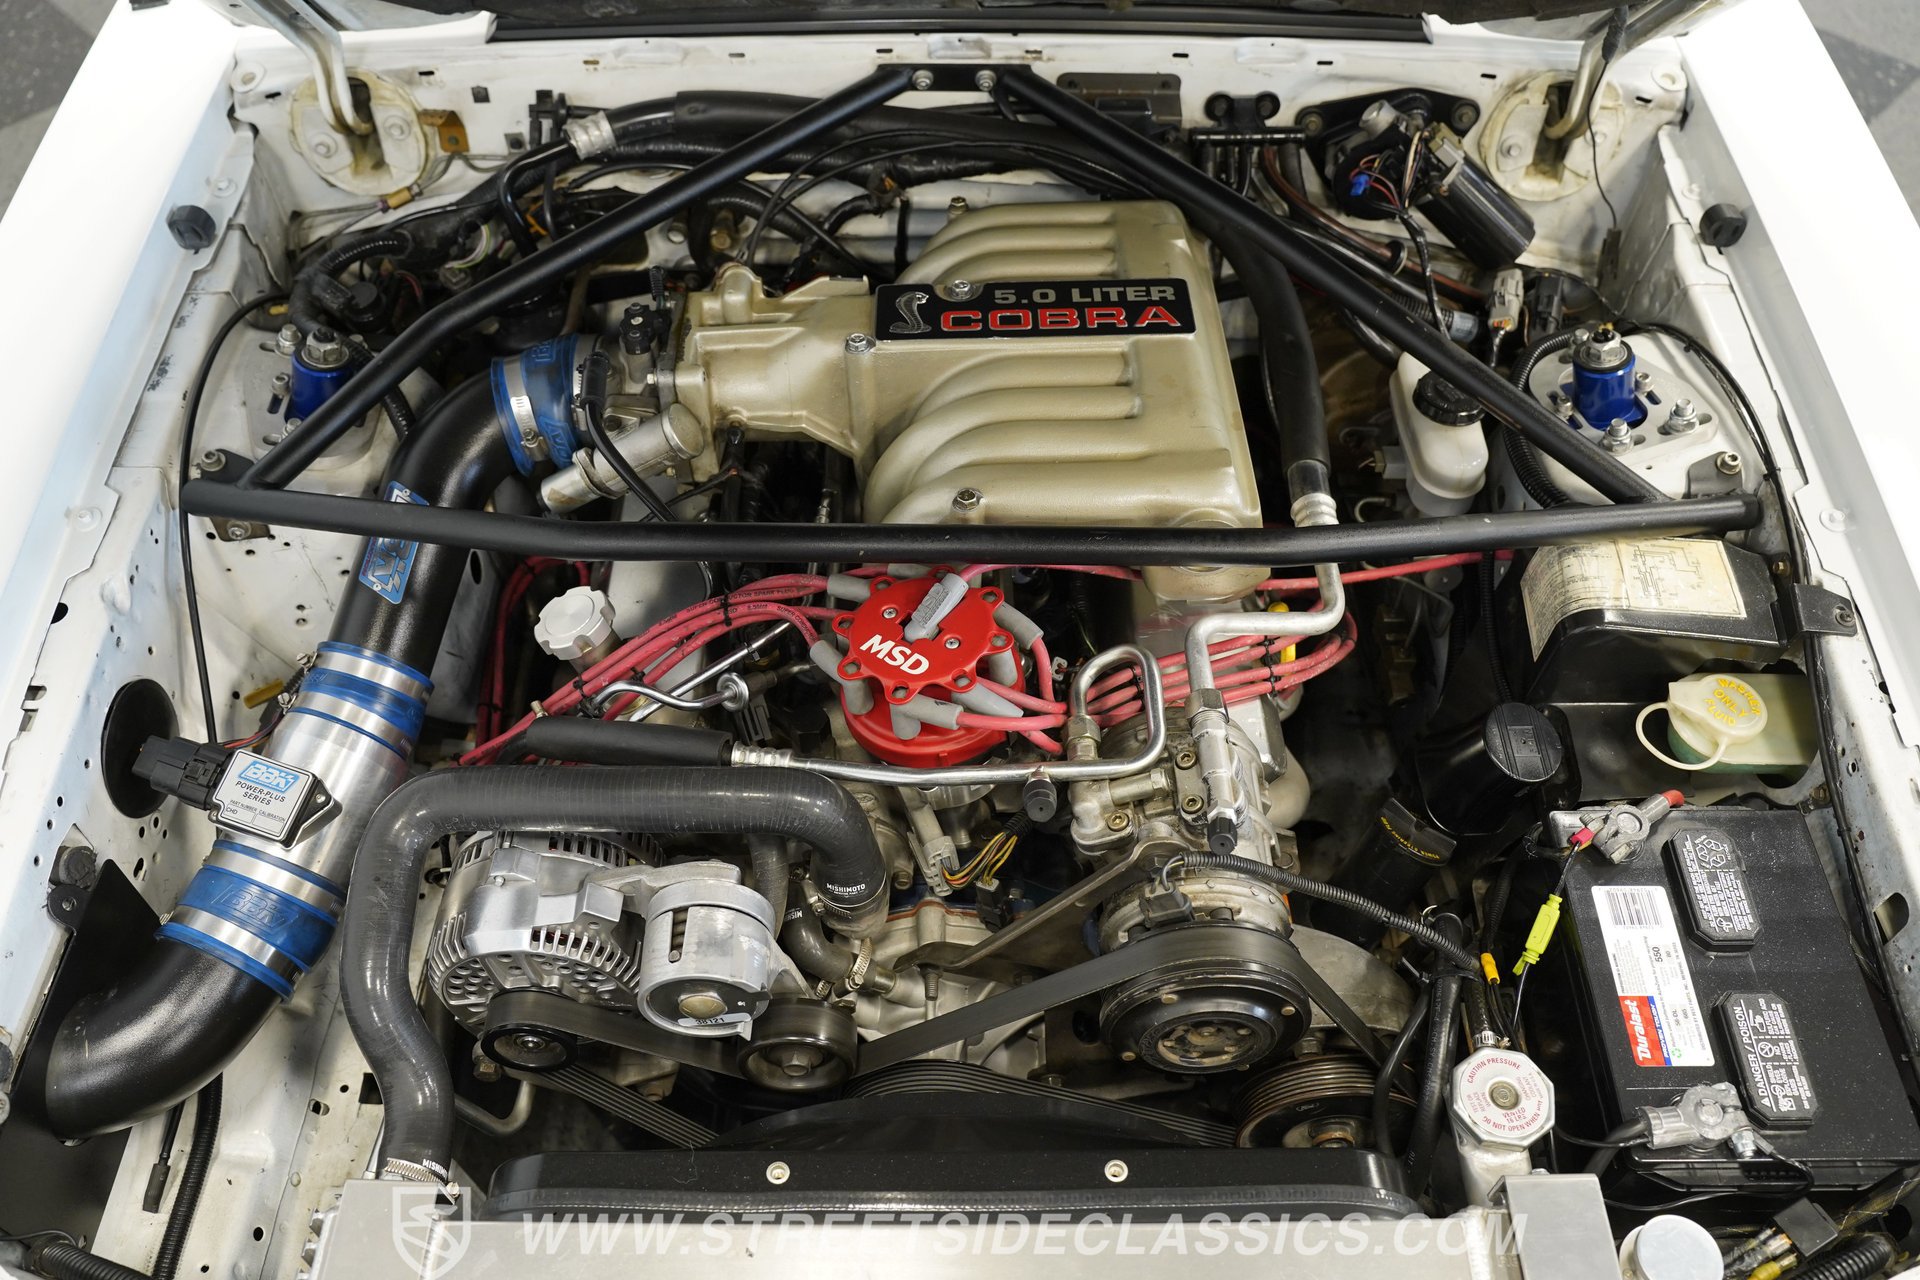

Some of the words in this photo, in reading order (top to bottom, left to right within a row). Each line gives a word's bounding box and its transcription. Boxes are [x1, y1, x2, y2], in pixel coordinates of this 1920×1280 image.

[994, 288, 1057, 304] 5.0
[1072, 286, 1176, 302] LITER
[940, 306, 1181, 332] COBRA
[860, 634, 930, 675] MSD
[1713, 689, 1749, 718] ONLY
[1717, 677, 1761, 715] WASHER
[1705, 698, 1737, 727] FLUID
[245, 763, 294, 789] BBK
[235, 780, 286, 803] POWER-PLUS
[242, 791, 272, 806] SERIES
[240, 803, 258, 812] NUMBER
[259, 810, 286, 822] CALIBRATION
[826, 883, 866, 893] MISHIMOTO
[1652, 946, 1663, 962] 550
[1759, 999, 1767, 1010] ACID
[1623, 999, 1653, 1061] Duralast
[1733, 1007, 1752, 1043] POISON
[1762, 1011, 1774, 1034] SULFURIC
[1657, 1030, 1669, 1057] PROVEN
[1774, 1046, 1782, 1055] NO
[1467, 1062, 1487, 1083] CAUTION
[1487, 1058, 1521, 1070] PRESSURE
[1747, 1055, 1768, 1095] DANGER
[1766, 1065, 1777, 1083] SHIELD
[1774, 1070, 1783, 1083] EYES
[1780, 1068, 1792, 1096] EXPLOSIVE
[1492, 1122, 1505, 1131] NOT
[1508, 1123, 1524, 1131] OPEN
[1524, 1112, 1540, 1128] WHEN
